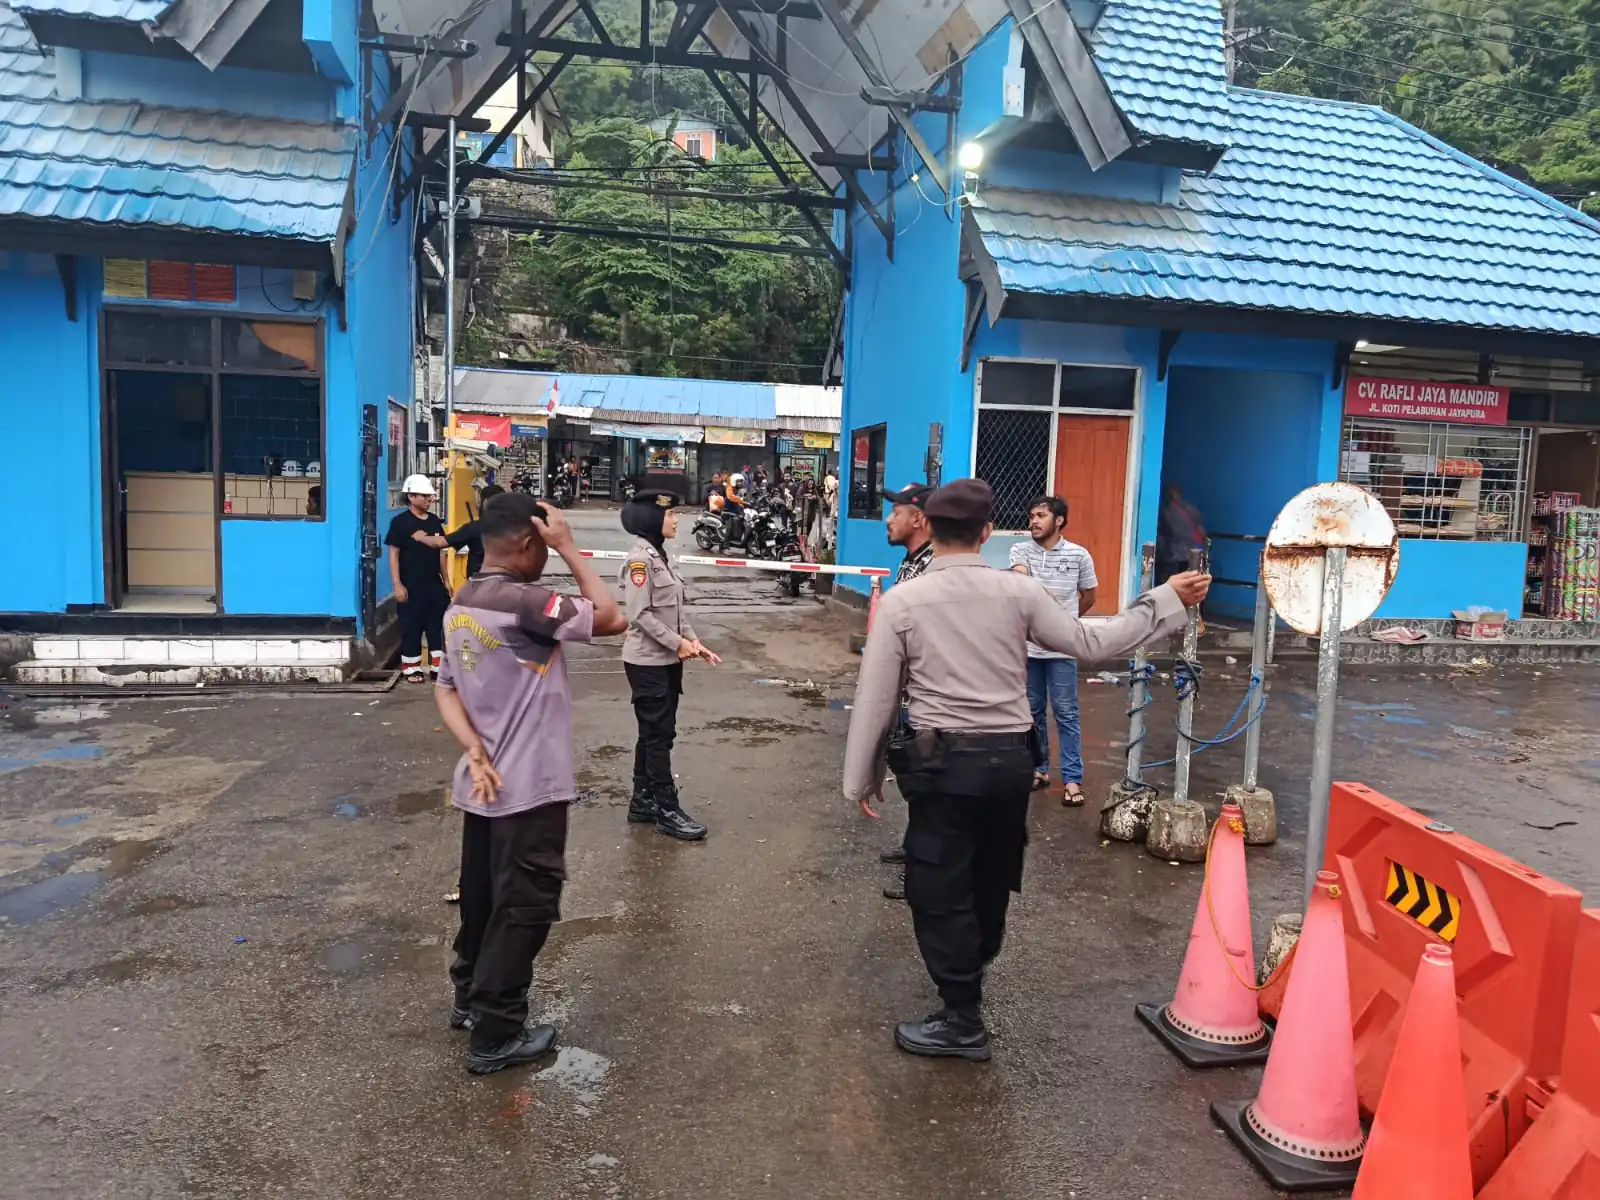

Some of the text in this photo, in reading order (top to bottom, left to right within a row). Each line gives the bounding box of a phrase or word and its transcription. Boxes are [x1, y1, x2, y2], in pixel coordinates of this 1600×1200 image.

[1358, 382, 1499, 406] CV. RAFLI JAYA MANDIRI
[1382, 404, 1400, 414] KOTI
[1402, 405, 1447, 417] PELABUHAN
[1447, 408, 1486, 419] JAYAPURA
